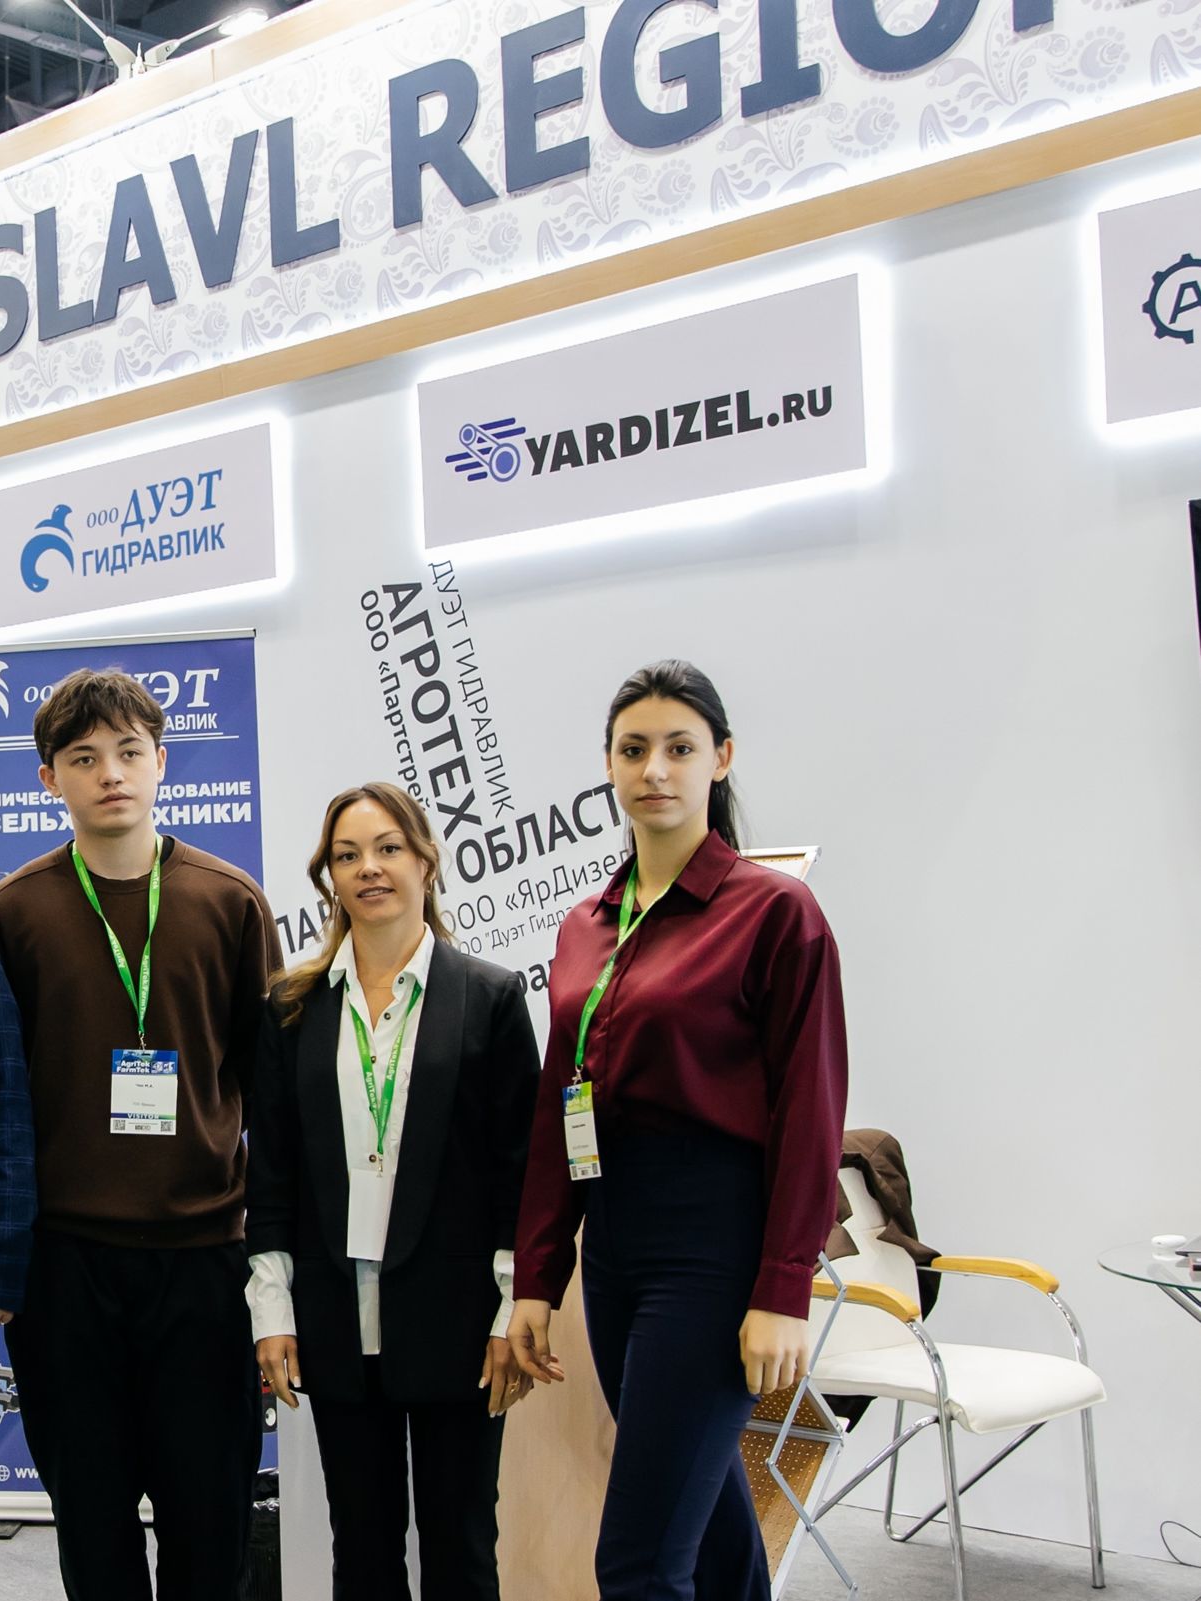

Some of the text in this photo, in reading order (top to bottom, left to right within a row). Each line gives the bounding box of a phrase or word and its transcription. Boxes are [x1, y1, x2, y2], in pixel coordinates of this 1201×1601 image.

[389, 0, 1054, 230] REGI
[524, 385, 832, 476] YARDIZEL.RU
[121, 468, 223, 537] ДУЭТ
[81, 522, 226, 576] ГИДРАВЛИК
[360, 589, 389, 652] ООО
[24, 668, 220, 710] ОО ЭТ
[163, 712, 218, 732] АВЛИК
[382, 582, 483, 842] АГРОТЕХ
[428, 560, 516, 819] ДУЭТ ГИДРАВЛИК
[157, 781, 251, 802] ДОВАНИЕ
[456, 782, 621, 884] ОБЛАСТ
